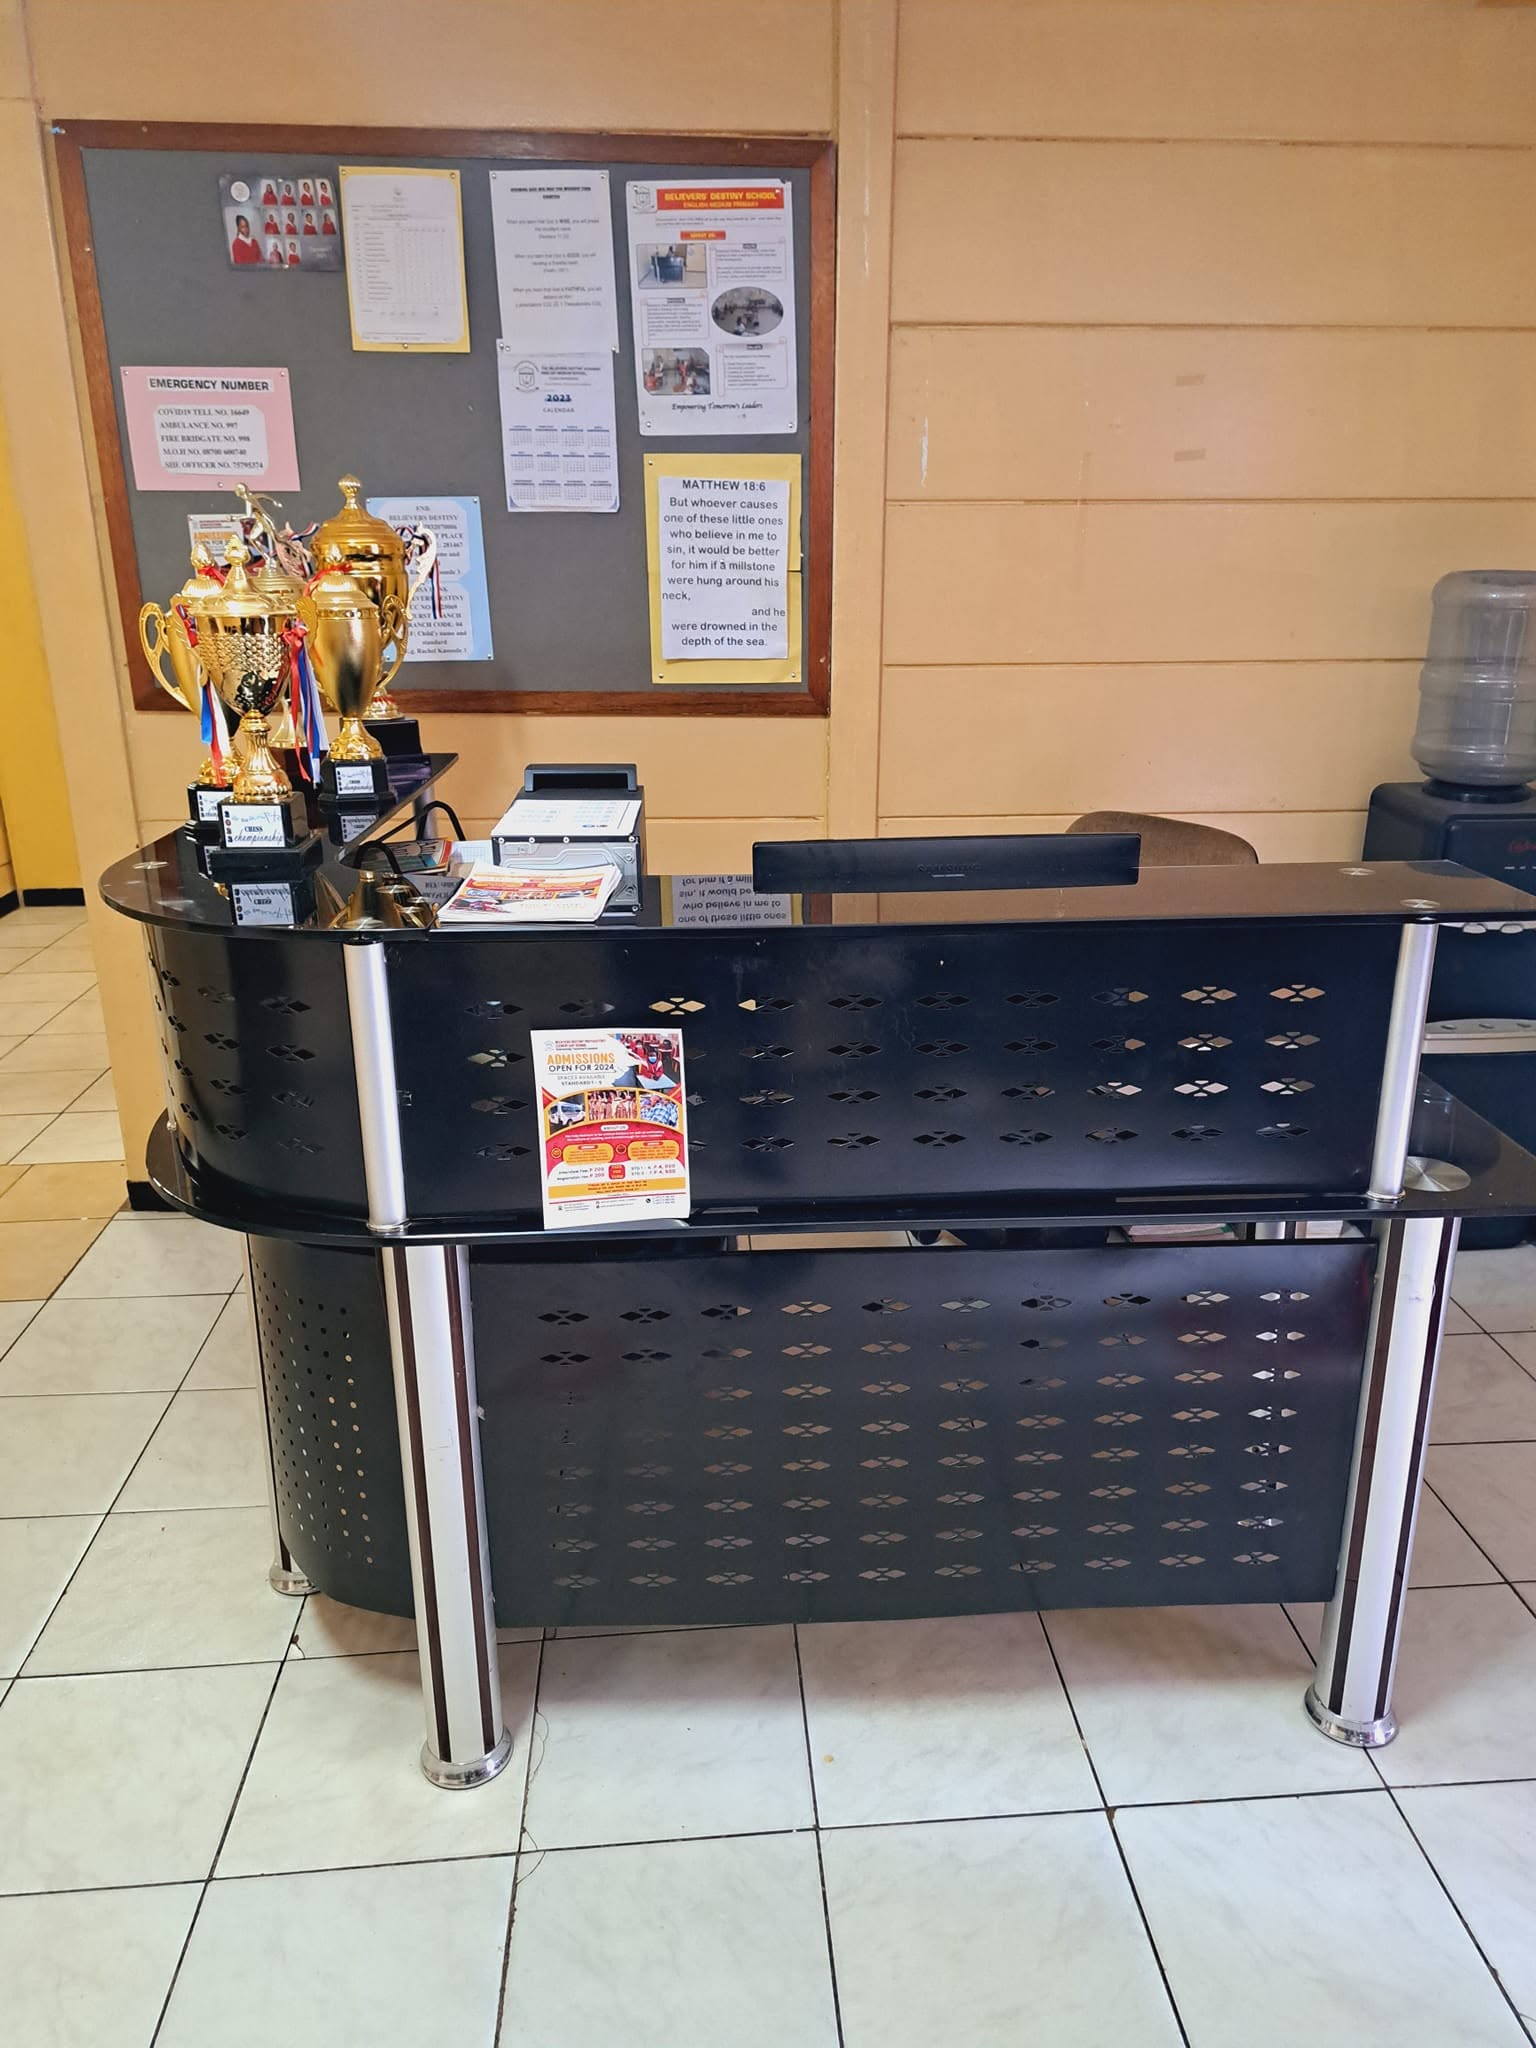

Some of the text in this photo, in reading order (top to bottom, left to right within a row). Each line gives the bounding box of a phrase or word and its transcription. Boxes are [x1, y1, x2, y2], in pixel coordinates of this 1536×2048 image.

[710, 192, 744, 200] DESTINY
[745, 191, 777, 200] SCHOOL
[149, 378, 269, 391] EMERGENCY NUMBER
[545, 394, 572, 402] 2023
[672, 403, 707, 412] Empowering
[682, 479, 766, 491] MATTHEW 18:6
[669, 497, 779, 510] But whoever causes
[663, 514, 784, 526] one of these little ones
[669, 529, 777, 541] who believe in me to
[666, 544, 780, 557] sin, it would be better
[671, 560, 776, 571] for him if a millstone
[667, 576, 780, 587] were hung around his
[661, 591, 691, 601] neck,
[751, 607, 786, 617] and he
[671, 621, 778, 632] were drowned in the
[681, 636, 768, 648] depth of the sea.
[547, 1052, 615, 1065] ADMISSIONS
